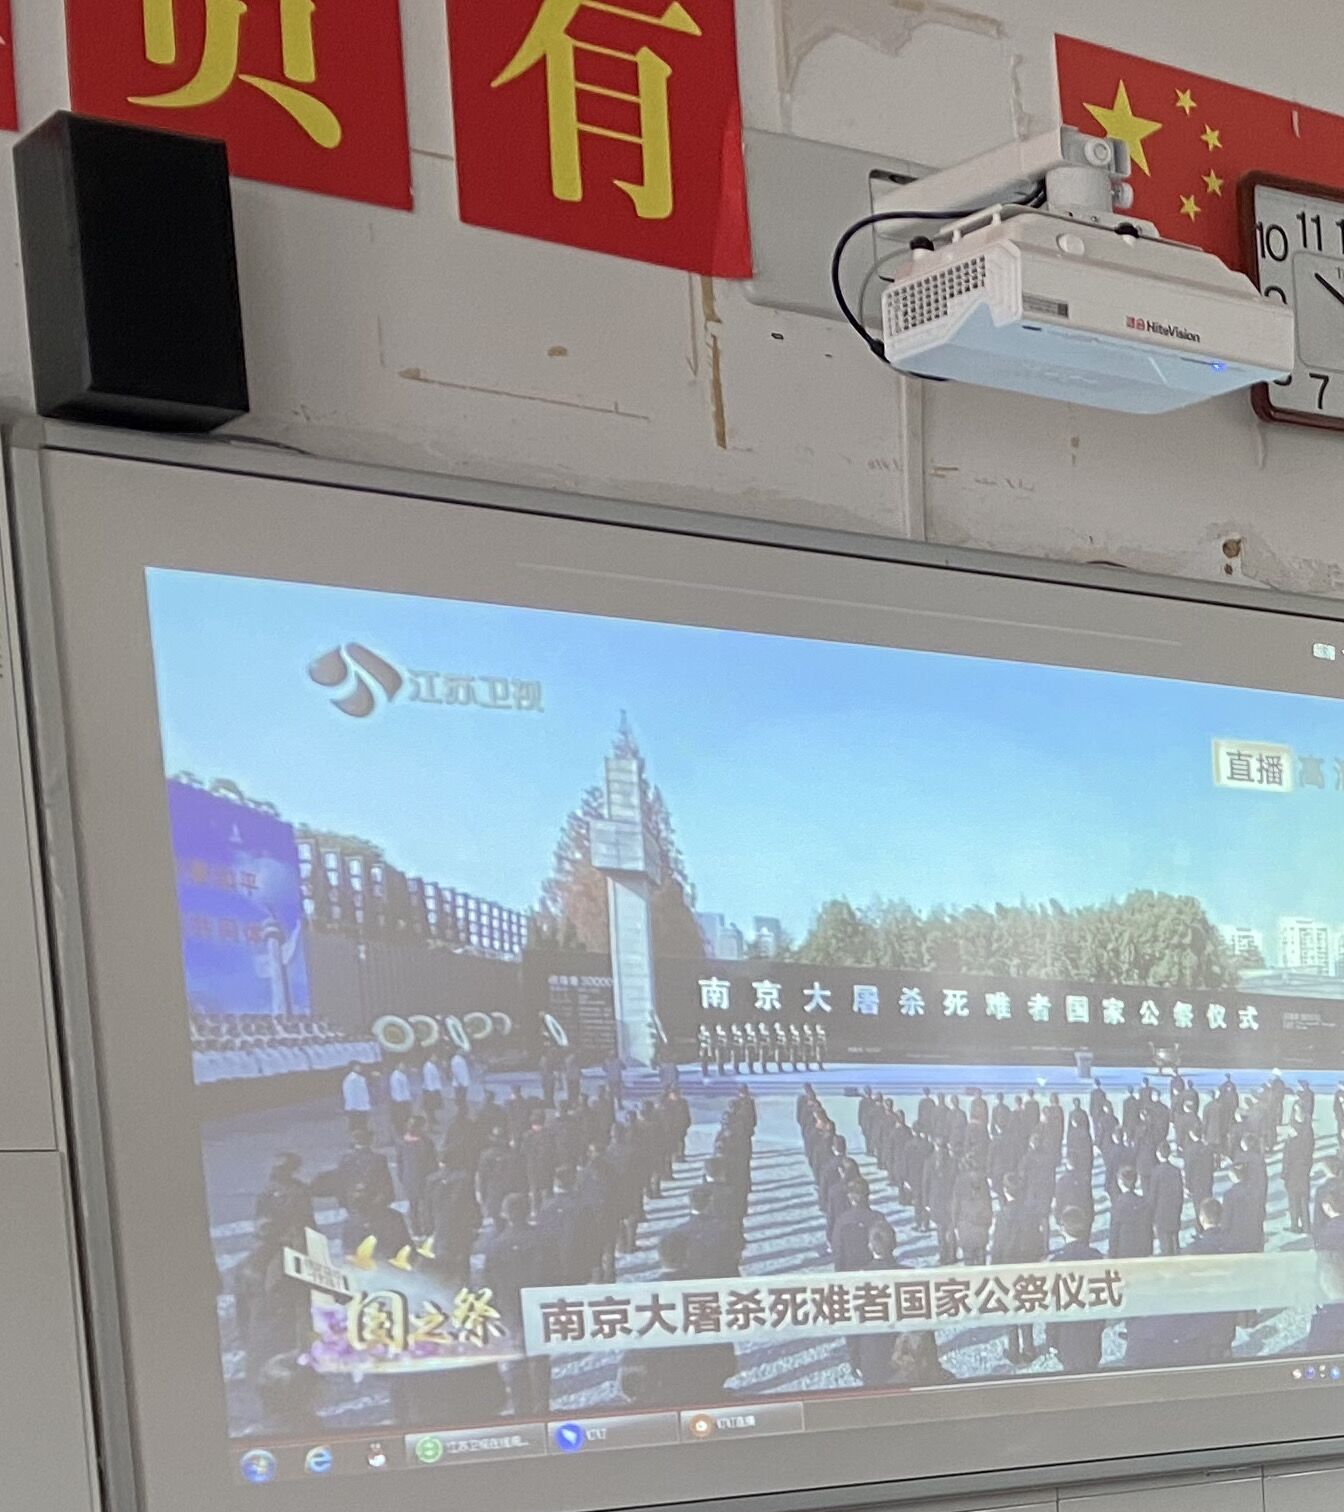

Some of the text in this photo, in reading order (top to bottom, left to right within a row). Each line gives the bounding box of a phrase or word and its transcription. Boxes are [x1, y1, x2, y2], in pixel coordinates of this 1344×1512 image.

[1258, 221, 1288, 262] 10
[1297, 210, 1322, 251] 11
[1146, 322, 1200, 343] HiteVision
[1309, 373, 1329, 409] 7
[409, 668, 544, 712] 江苏卫视
[1225, 749, 1284, 787] 直播
[698, 978, 1260, 1030] 南京大屠杀死难者国家公祭仪式
[540, 1269, 1124, 1342] 南京大屠杀死难者国家公祭仪式
